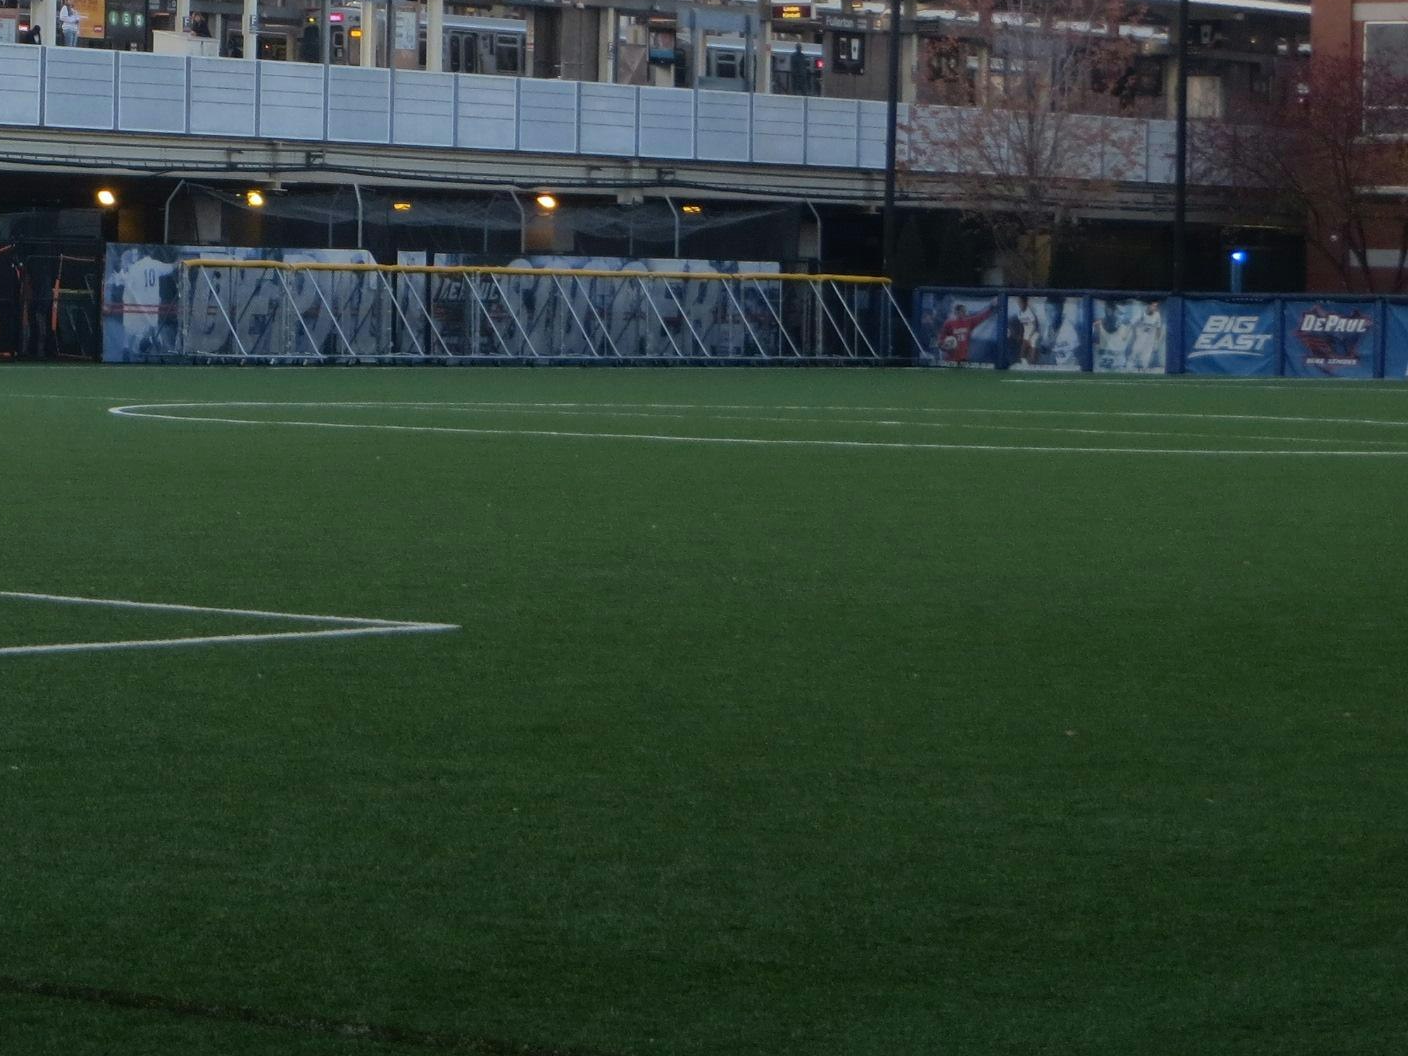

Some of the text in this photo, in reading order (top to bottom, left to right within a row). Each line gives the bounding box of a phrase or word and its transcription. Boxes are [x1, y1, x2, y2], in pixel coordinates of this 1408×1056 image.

[826, 16, 854, 28] Fullerton
[1204, 315, 1261, 333] BIG
[1193, 333, 1273, 351] EAST
